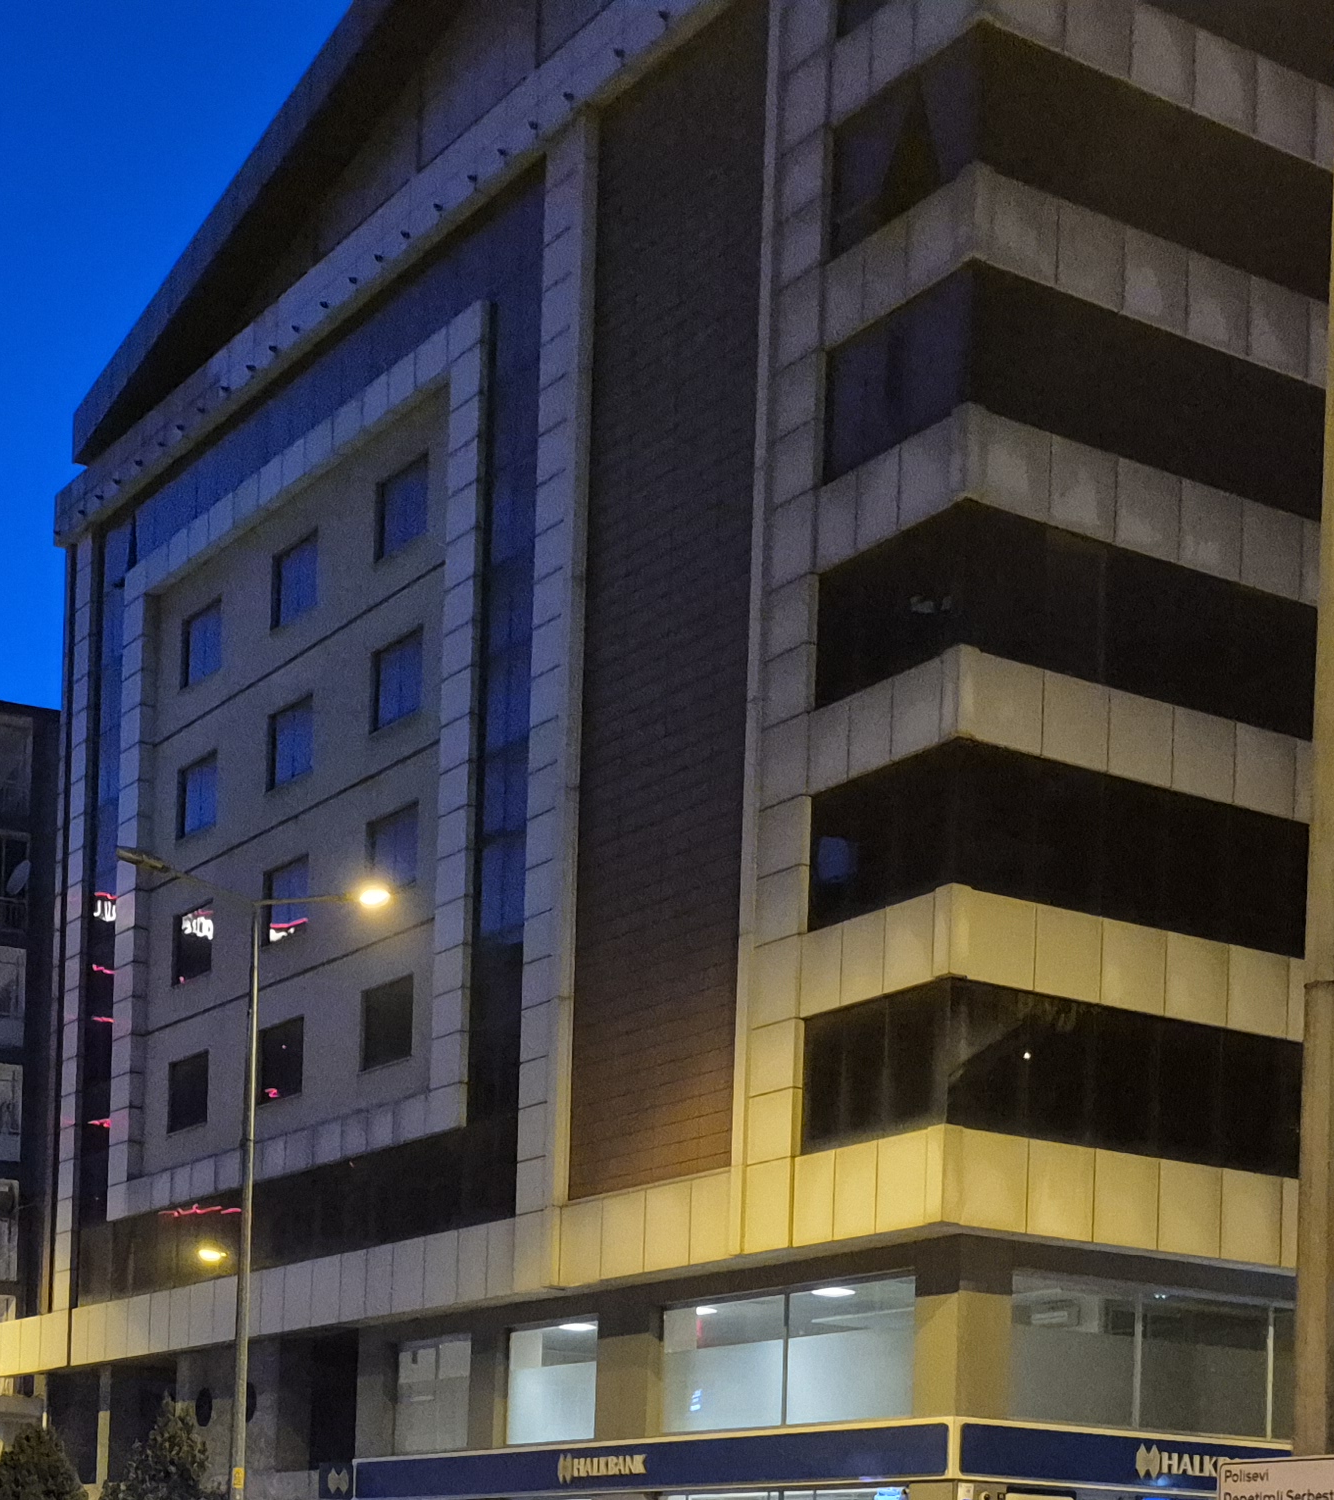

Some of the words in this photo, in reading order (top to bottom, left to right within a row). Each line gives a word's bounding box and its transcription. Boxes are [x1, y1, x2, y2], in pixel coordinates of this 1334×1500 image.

[573, 1453, 647, 1477] HALKBANK
[1162, 1452, 1229, 1476] HALK
[1224, 1469, 1269, 1484] Polisevi
